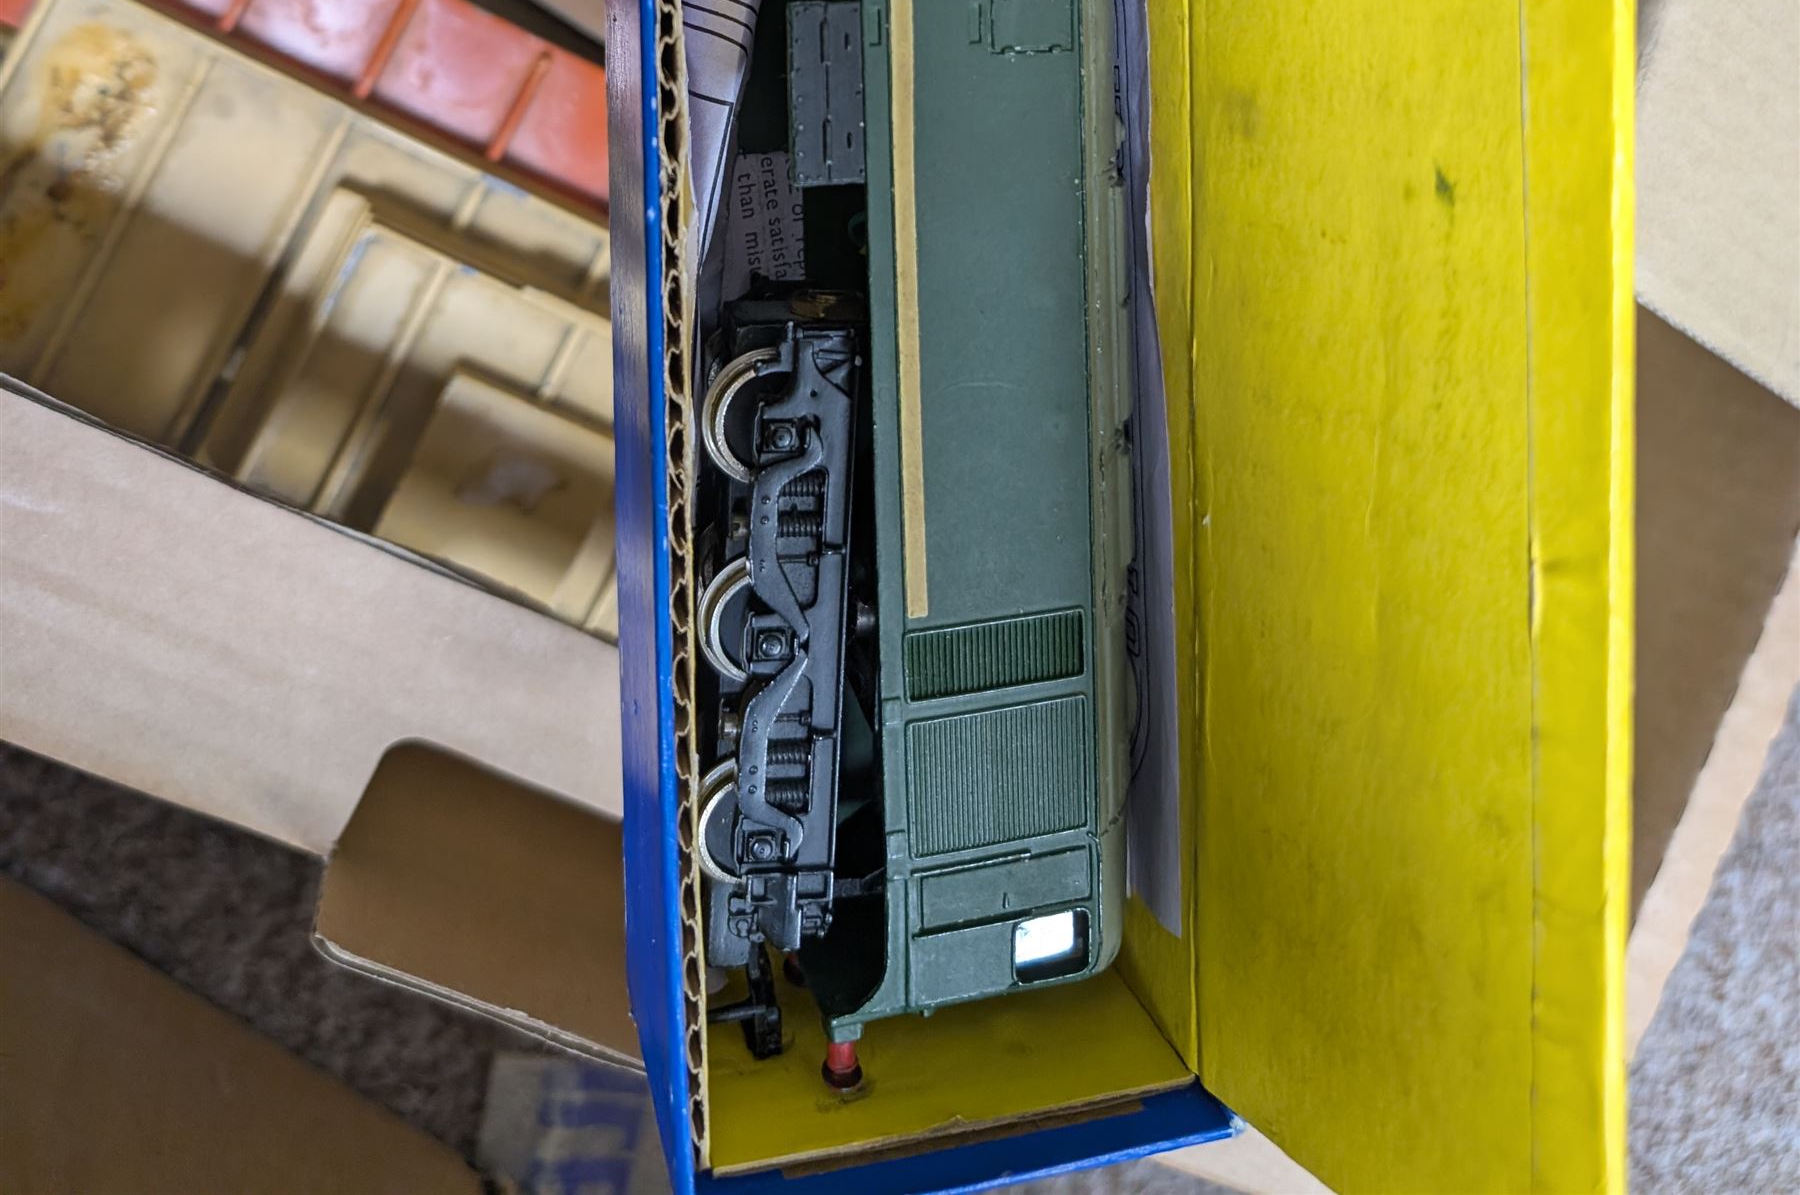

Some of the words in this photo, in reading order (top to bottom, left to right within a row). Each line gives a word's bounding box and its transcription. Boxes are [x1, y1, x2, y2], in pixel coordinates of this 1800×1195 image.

[738, 172, 756, 220] than
[760, 156, 779, 211] erate
[768, 217, 792, 280] satisfa
